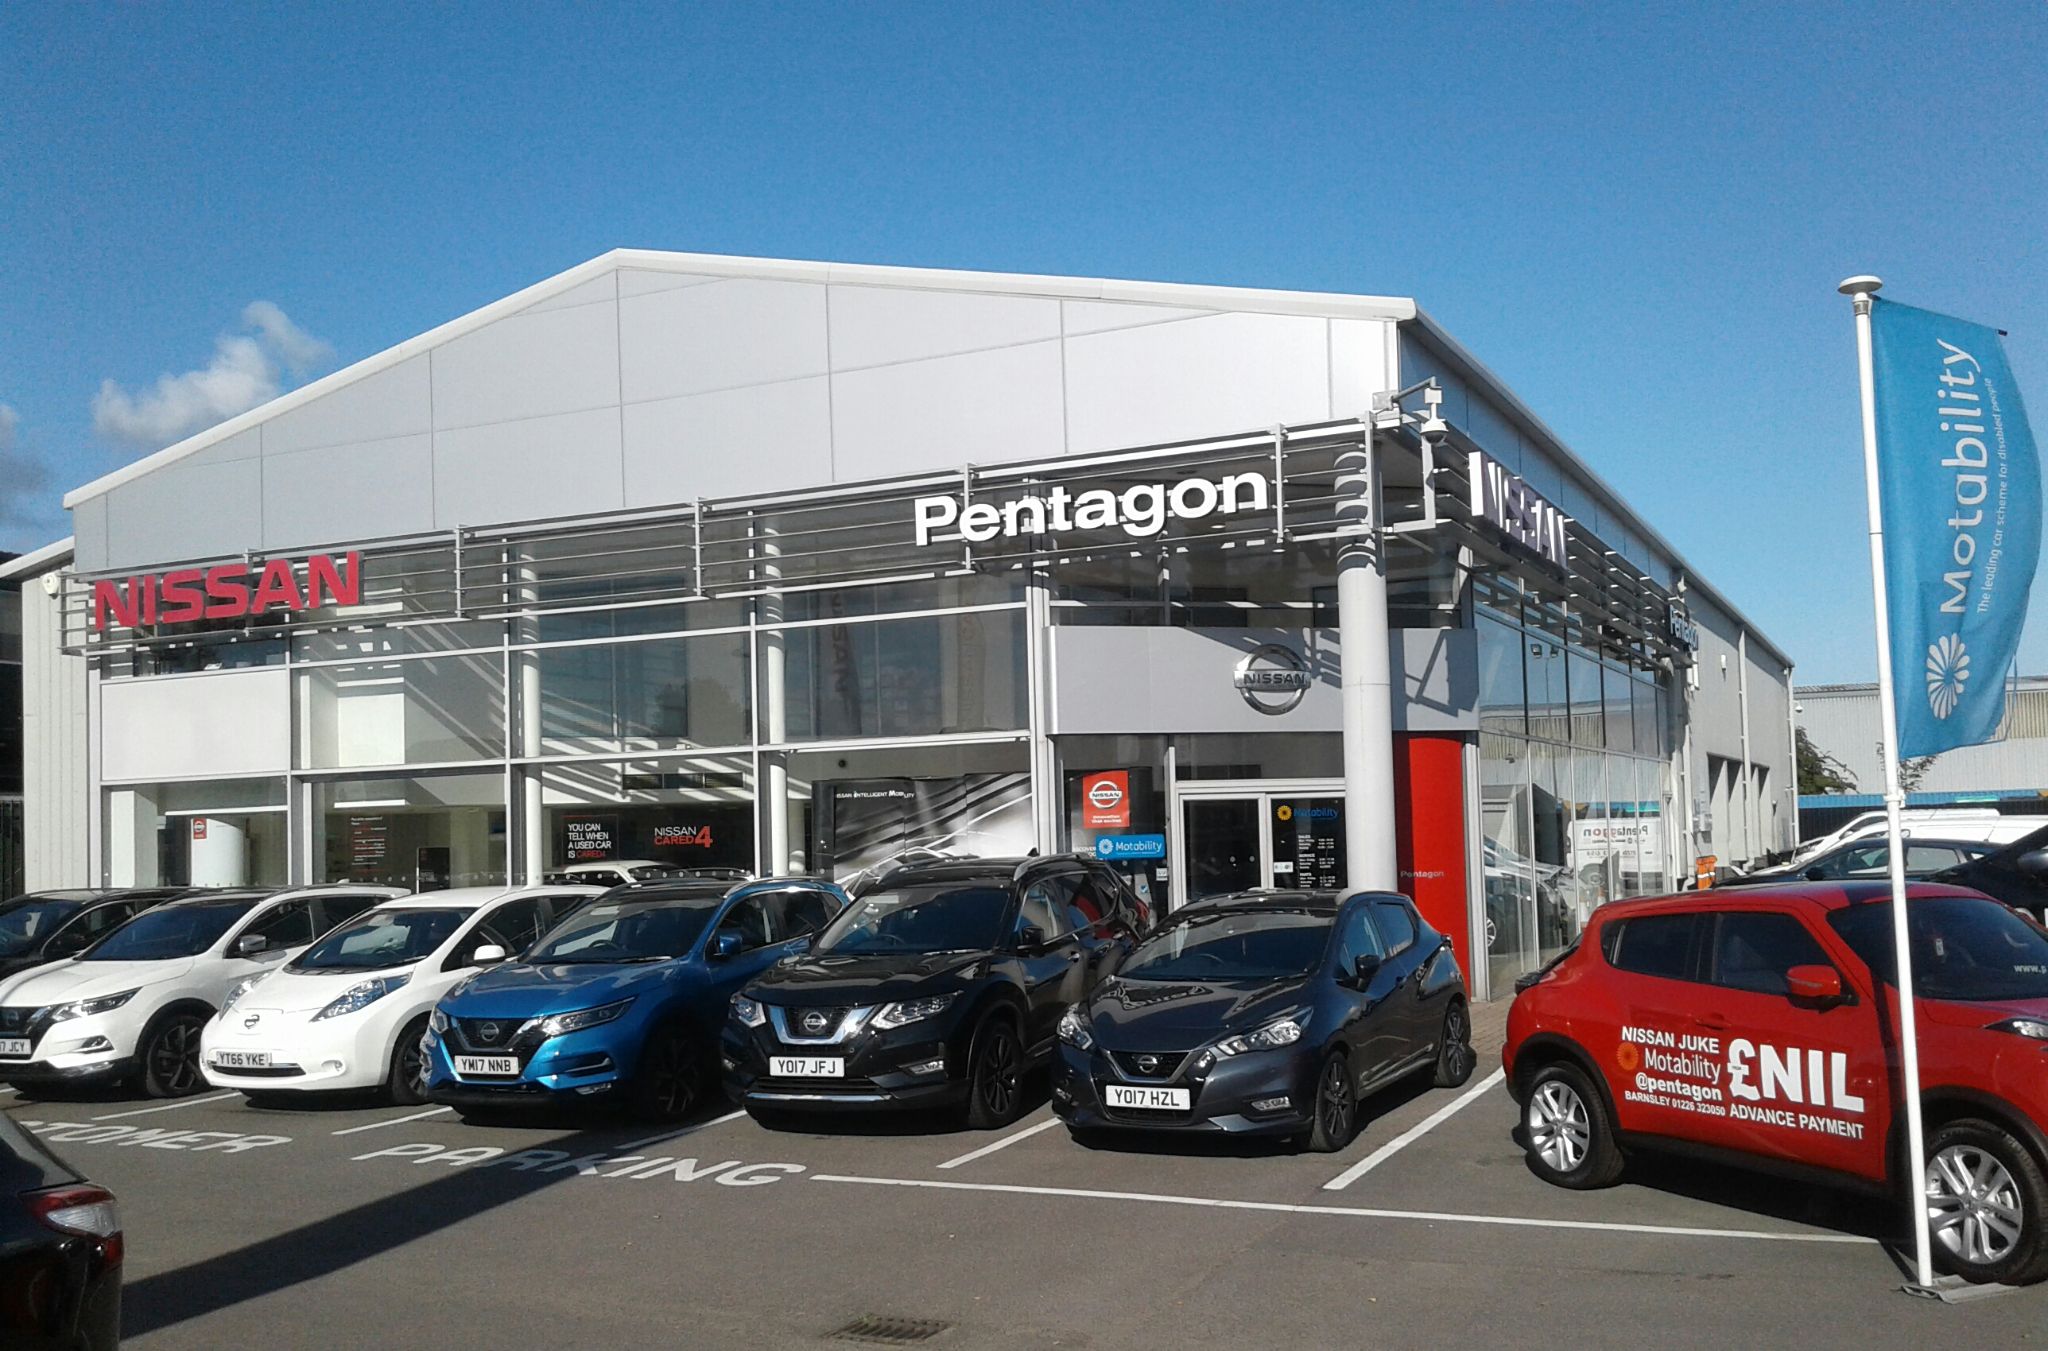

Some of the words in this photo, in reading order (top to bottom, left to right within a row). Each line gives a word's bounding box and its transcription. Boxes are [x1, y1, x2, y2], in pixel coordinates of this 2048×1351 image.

[1992, 414, 2007, 460] disabled
[1937, 338, 1989, 613] Motability
[1998, 463, 2008, 478] for
[914, 471, 1270, 546] Pentagon
[1996, 481, 2009, 526] scheme
[1992, 529, 2004, 547] car
[1981, 549, 2003, 591] leading
[94, 551, 361, 631] NISSAN
[1977, 593, 1991, 613] The
[1243, 673, 1306, 685] NISSAN
[1294, 807, 1338, 819] Motability
[568, 823, 584, 832] YOU
[585, 823, 601, 832] CAN
[568, 832, 585, 841] TELL
[586, 831, 609, 840] WHEN
[654, 826, 697, 837] NISSAN
[568, 841, 574, 850] A
[574, 841, 595, 850] USED
[595, 840, 612, 849] CAR
[1115, 840, 1162, 853] Motability
[568, 850, 576, 859] IS
[1400, 870, 1444, 879] Pentagon
[9, 1041, 25, 1052] JCY
[1621, 1026, 1675, 1048] NISSAN
[1678, 1034, 1720, 1054] JUKE
[219, 1052, 244, 1065] YT66
[245, 1053, 265, 1066] YKE
[461, 1058, 485, 1072] YM17
[488, 1059, 511, 1072] NNB
[778, 1059, 806, 1074] YO17
[810, 1060, 836, 1074] JFJ
[1644, 1047, 1721, 1085] Motability
[1727, 1038, 1864, 1113] £NIL
[1635, 1071, 1723, 1101] @pentagon
[1114, 1088, 1146, 1105] YO17
[1150, 1090, 1180, 1107] HZL
[1624, 1090, 1671, 1107] BARNSLEY
[1672, 1098, 1696, 1112] 01226
[1696, 1103, 1727, 1117] 323050
[1729, 1103, 1797, 1128] ADVANCE
[1799, 1113, 1864, 1140] PAYMENT
[350, 1143, 807, 1187] PARKING
